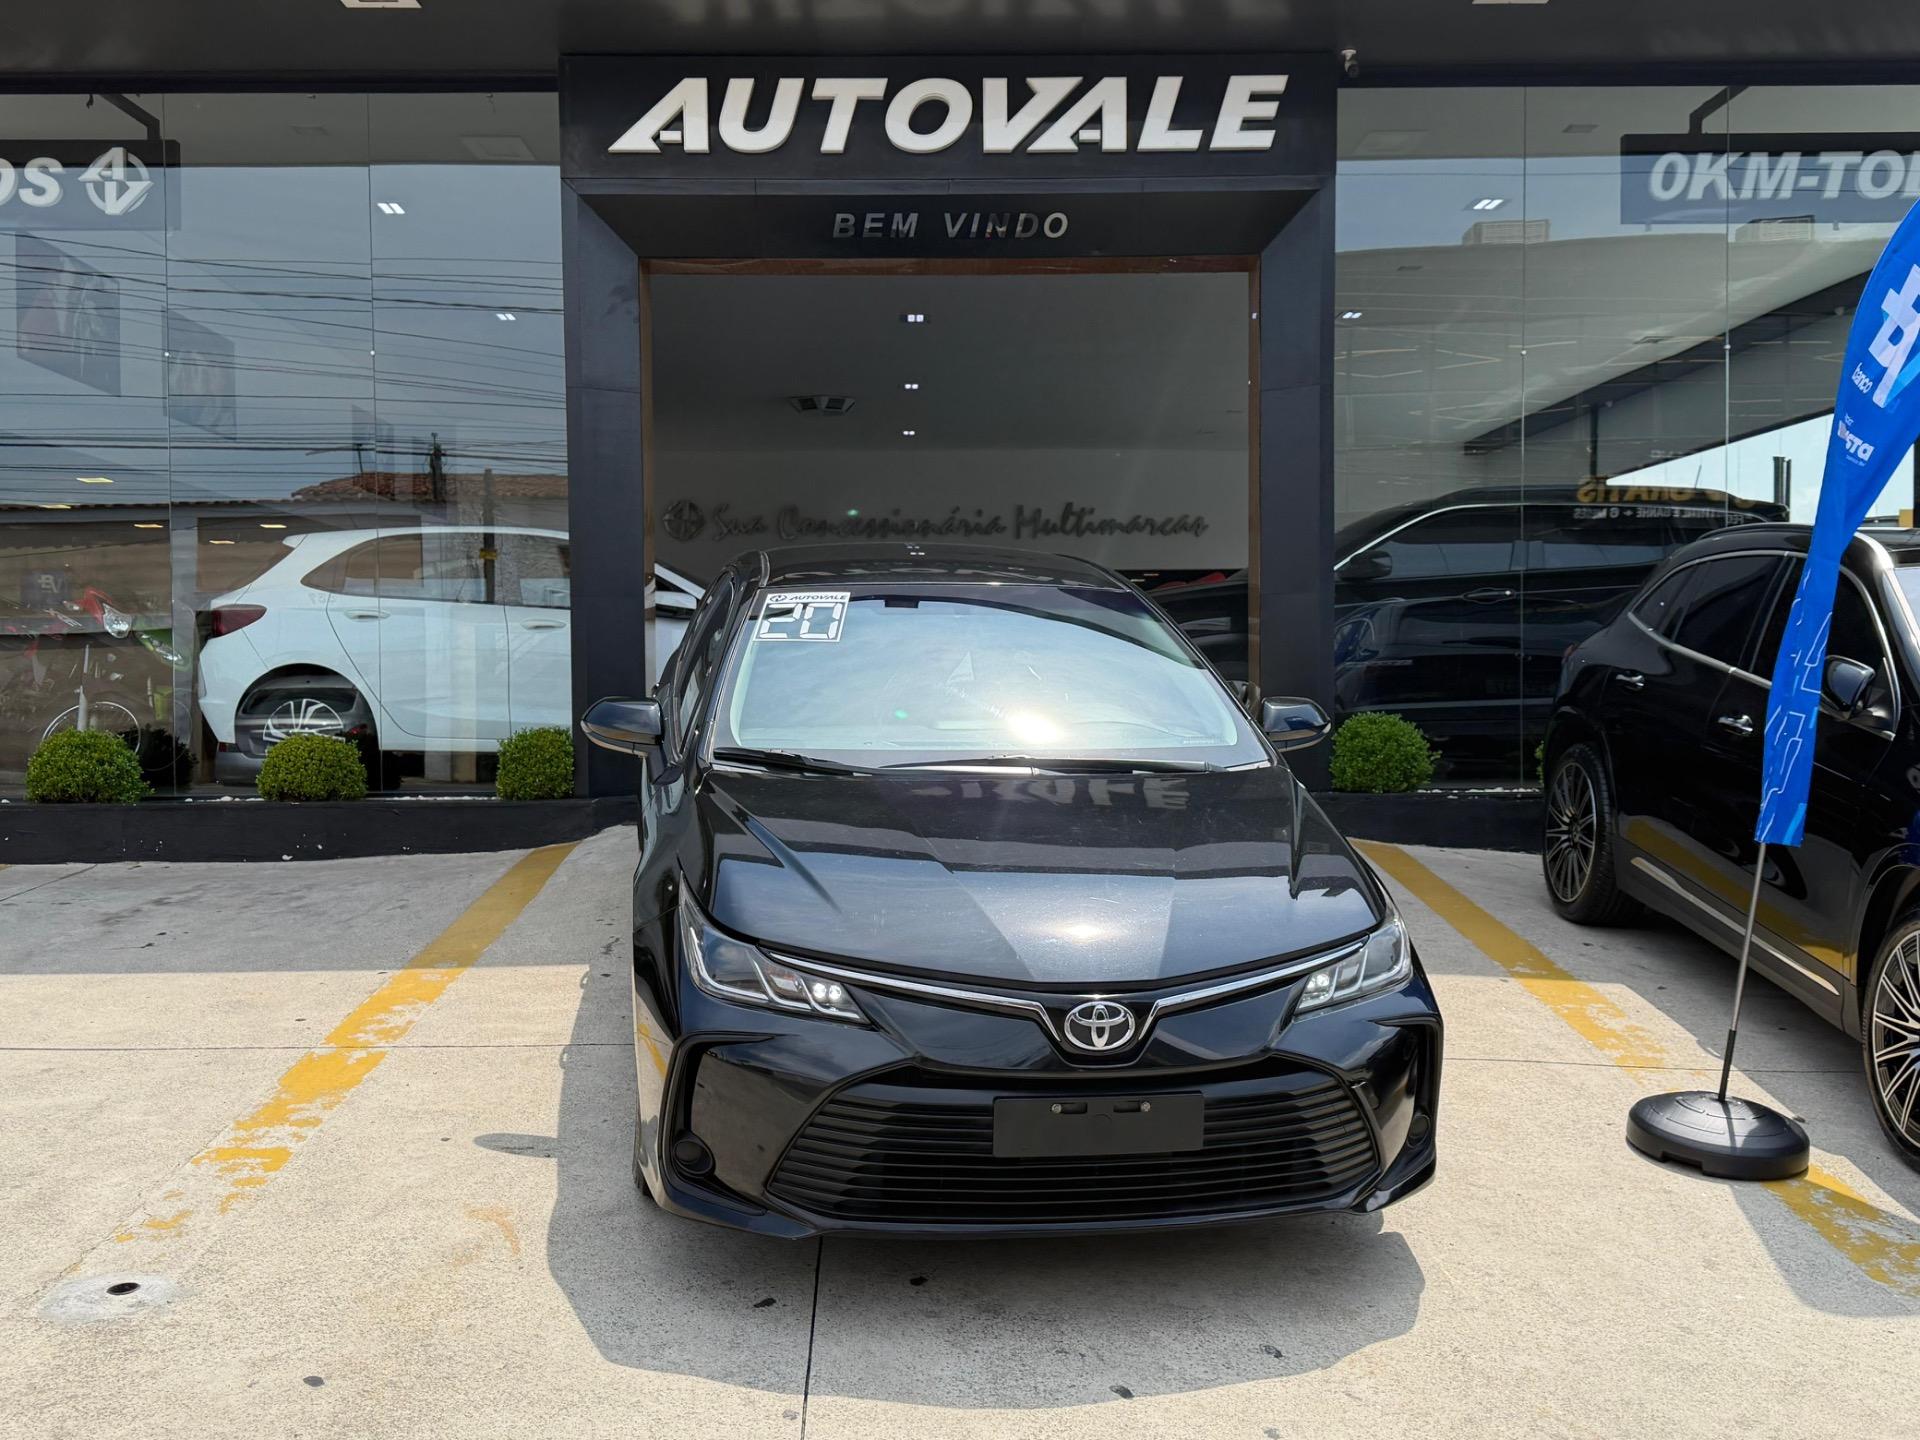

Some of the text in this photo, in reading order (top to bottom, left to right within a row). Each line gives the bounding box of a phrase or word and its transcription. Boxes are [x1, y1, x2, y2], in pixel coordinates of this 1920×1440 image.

[608, 75, 1289, 155] AUTOVALE
[833, 212, 1068, 239] BEM VINDO
[712, 503, 768, 541] Sua
[1015, 501, 1210, 540] Multimarcas
[759, 602, 842, 639] 20
